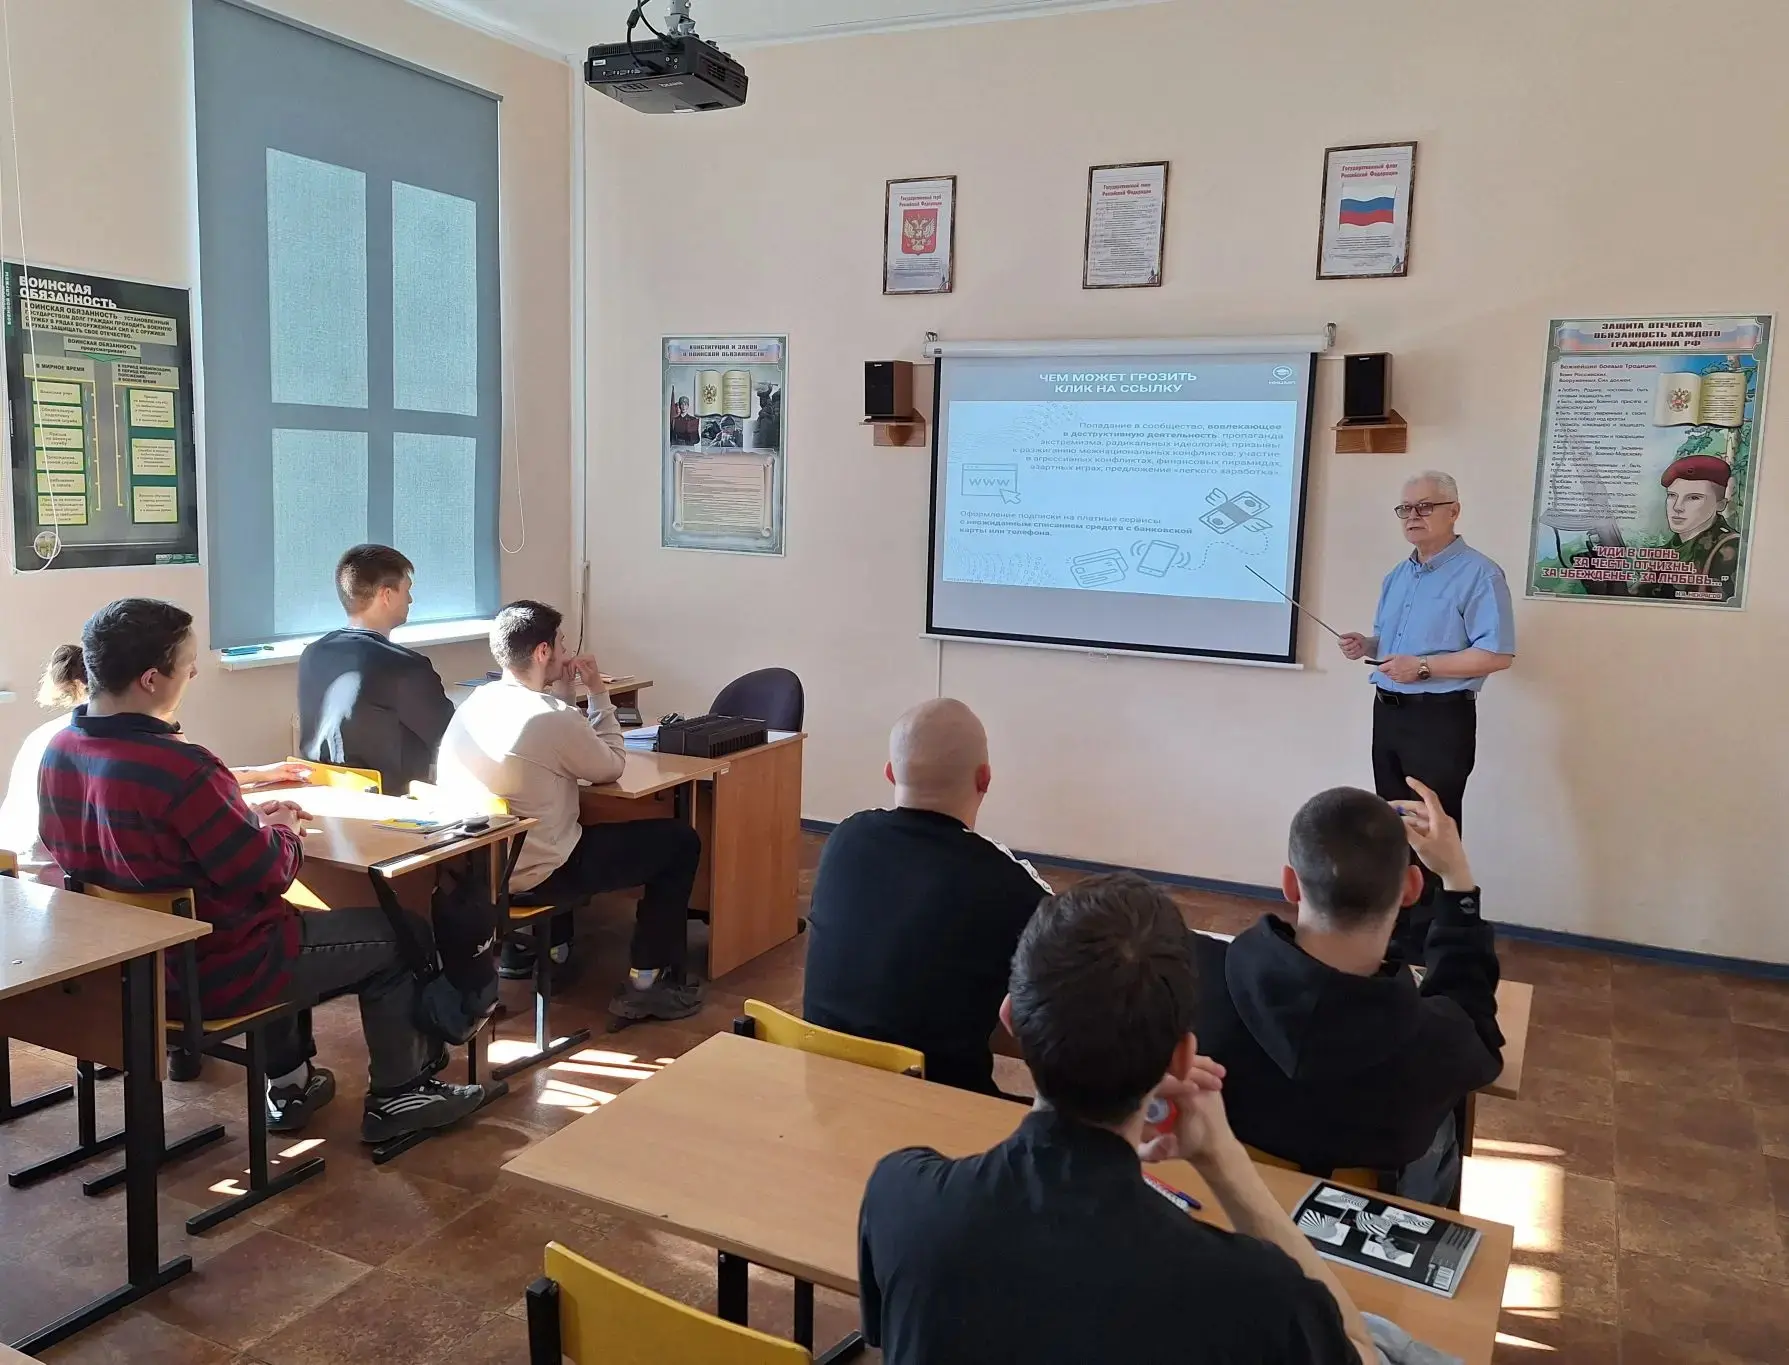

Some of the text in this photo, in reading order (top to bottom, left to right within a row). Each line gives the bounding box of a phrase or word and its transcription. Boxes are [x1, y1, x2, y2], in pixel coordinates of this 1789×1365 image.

[19, 275, 92, 296] ВОИНСКАЯ
[19, 287, 117, 309] ОБЯЗАННОСТЬ
[24, 302, 65, 313] ВОИНСКАЯ
[66, 307, 118, 319] ОБЯЗАННОСТЬ
[124, 315, 170, 326] УСТАНОВЛЕННЫЙ
[87, 316, 114, 325] ГРАЖДАН
[114, 320, 146, 329] ПРОХОДИТЬ
[1601, 322, 1644, 330] ЗАЩИТА
[1648, 321, 1703, 329] ОТЕЧЕСТВА
[1593, 330, 1721, 339] ОБЯЗАННОСТЬ КАЖДОГО
[1610, 340, 1680, 348] ГРАЖДАНИНА
[1039, 372, 1198, 382] ЧЕМ МОЖЕТ ГРОЗИТЬ
[1054, 384, 1184, 393] КЛИК НА ССЫЛКУ
[1079, 422, 1133, 430] Попадание
[1142, 422, 1205, 431] сообщество,
[1207, 423, 1282, 431] вовлекающее
[1070, 431, 1145, 439] деструктивную
[1222, 433, 1284, 441] пропаганда
[1105, 440, 1171, 448] радикальных
[1231, 442, 1281, 450] призывы
[1238, 451, 1281, 459] участие
[1033, 456, 1093, 464] агрессивных
[1156, 458, 1220, 466] финансовых
[1105, 465, 1171, 473] предложение
[960, 510, 1017, 518] Оформление
[1018, 513, 1061, 521] подписки
[1134, 525, 1193, 534] банковской
[1627, 547, 1636, 558] В
[1639, 548, 1680, 560] ОГОНЬ
[1572, 557, 1697, 574] ЗА ЧЕСТЬ ОТЧИЗНЫ,
[1542, 567, 1557, 577] ЗА
[1559, 568, 1638, 583] УБЕЖДЕНЬЕ,
[1639, 571, 1659, 584] ЗА
